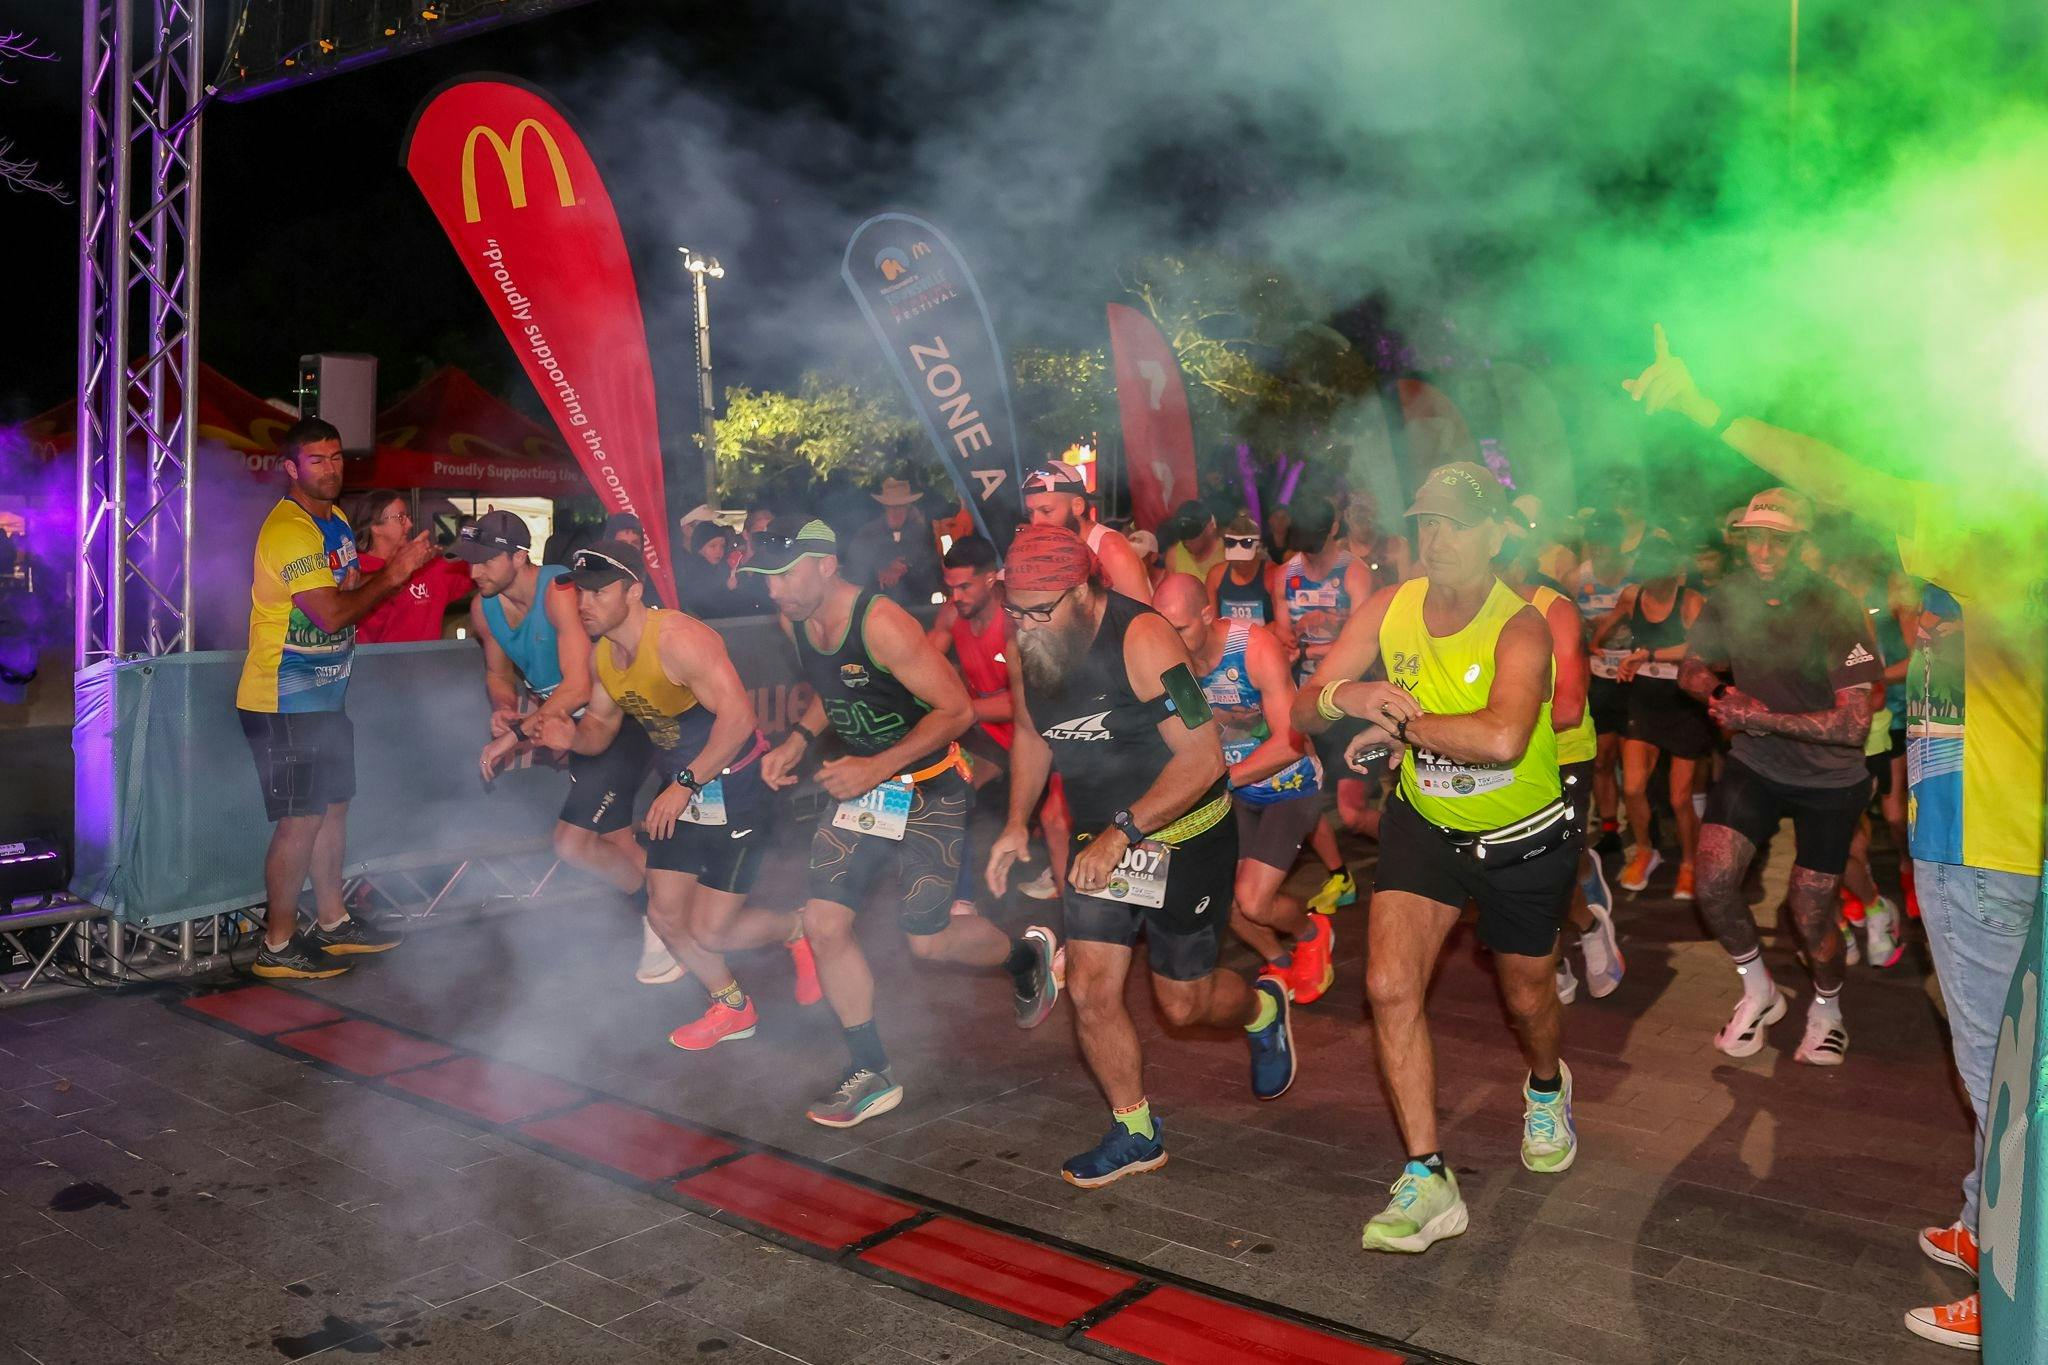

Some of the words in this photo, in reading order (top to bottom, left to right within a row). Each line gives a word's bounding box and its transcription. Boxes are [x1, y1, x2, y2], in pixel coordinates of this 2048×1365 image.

[524, 324, 588, 427] supporting
[583, 429, 606, 461] the
[909, 336, 993, 458] ZONE
[971, 469, 1007, 501] A
[434, 461, 484, 480] Proudly
[487, 464, 558, 483] Supporting
[1231, 606, 1252, 618] 303
[1393, 651, 1419, 676] 24
[1041, 729, 1110, 741] ALTRA
[1425, 764, 1436, 772] 10
[1439, 765, 1467, 773] YEAR
[1129, 871, 1154, 881] CLUB
